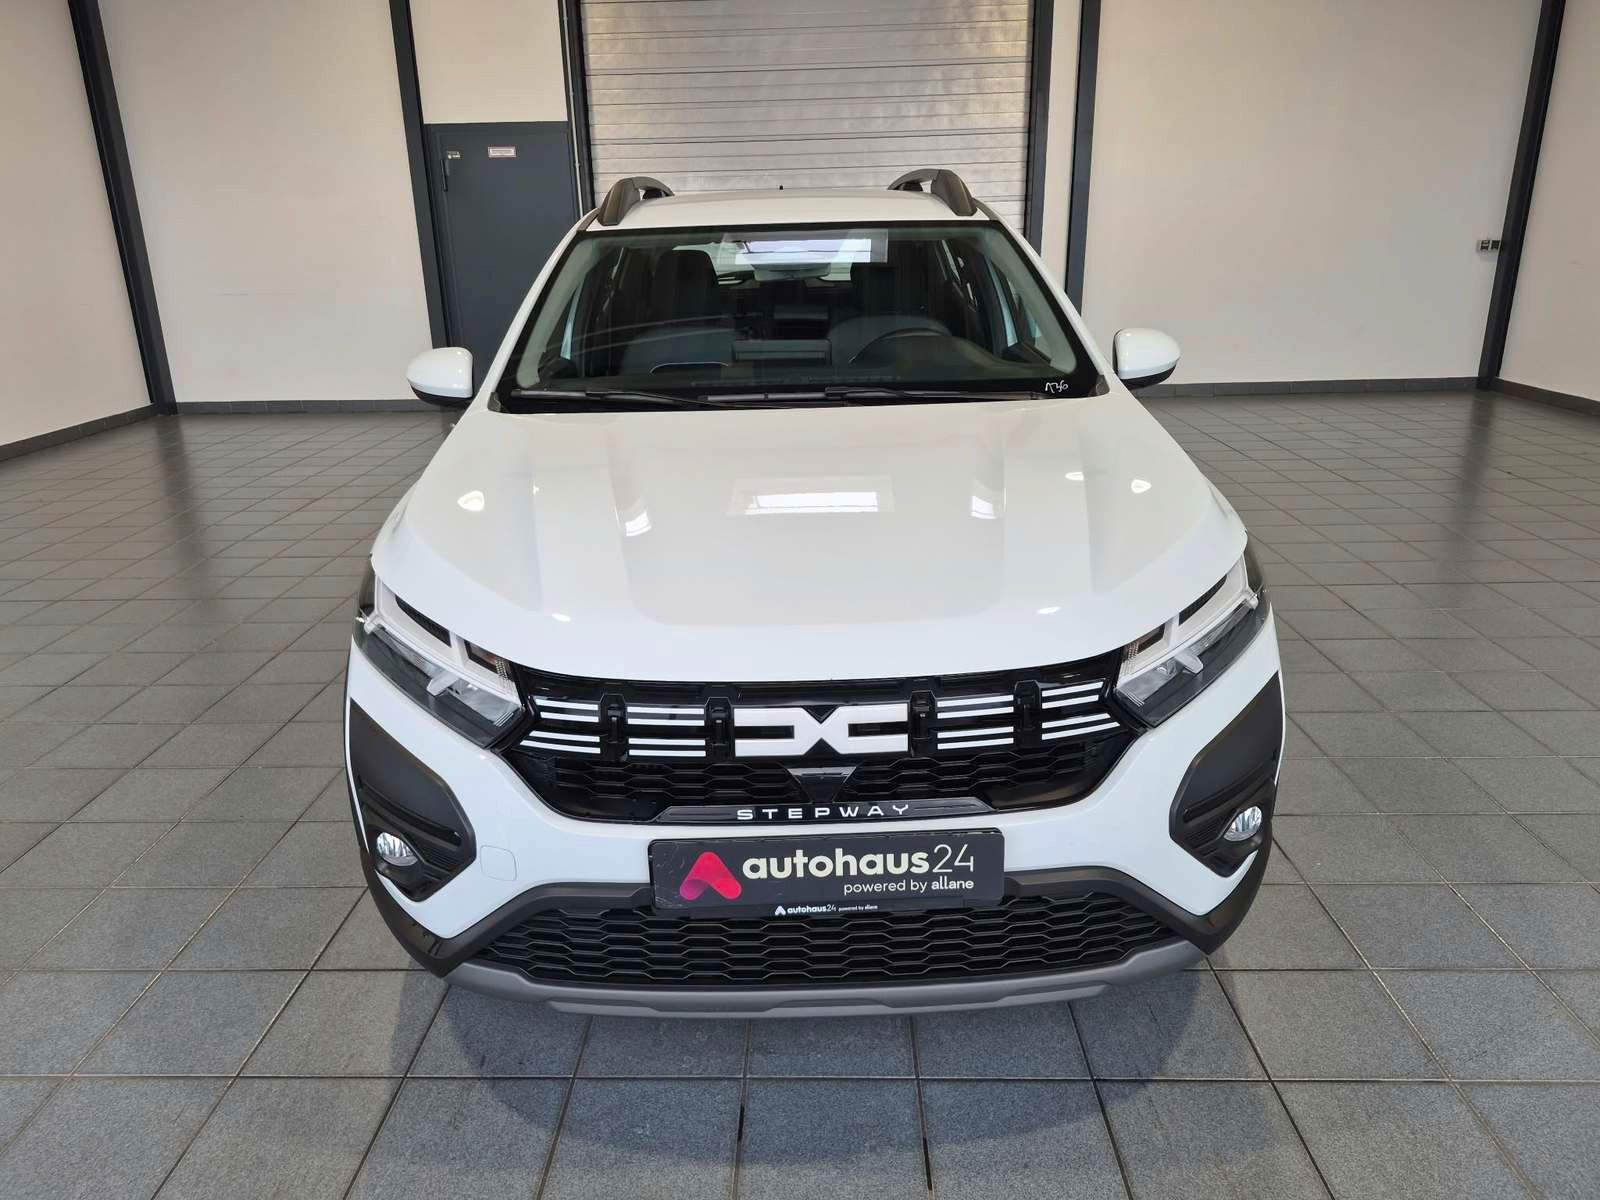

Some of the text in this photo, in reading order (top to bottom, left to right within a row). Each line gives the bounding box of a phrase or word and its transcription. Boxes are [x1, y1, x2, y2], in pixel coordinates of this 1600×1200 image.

[736, 804, 909, 821] STEPWAY
[742, 843, 975, 880] autohaus24
[843, 875, 975, 896] powered by allane
[787, 903, 837, 914] autohaus24
